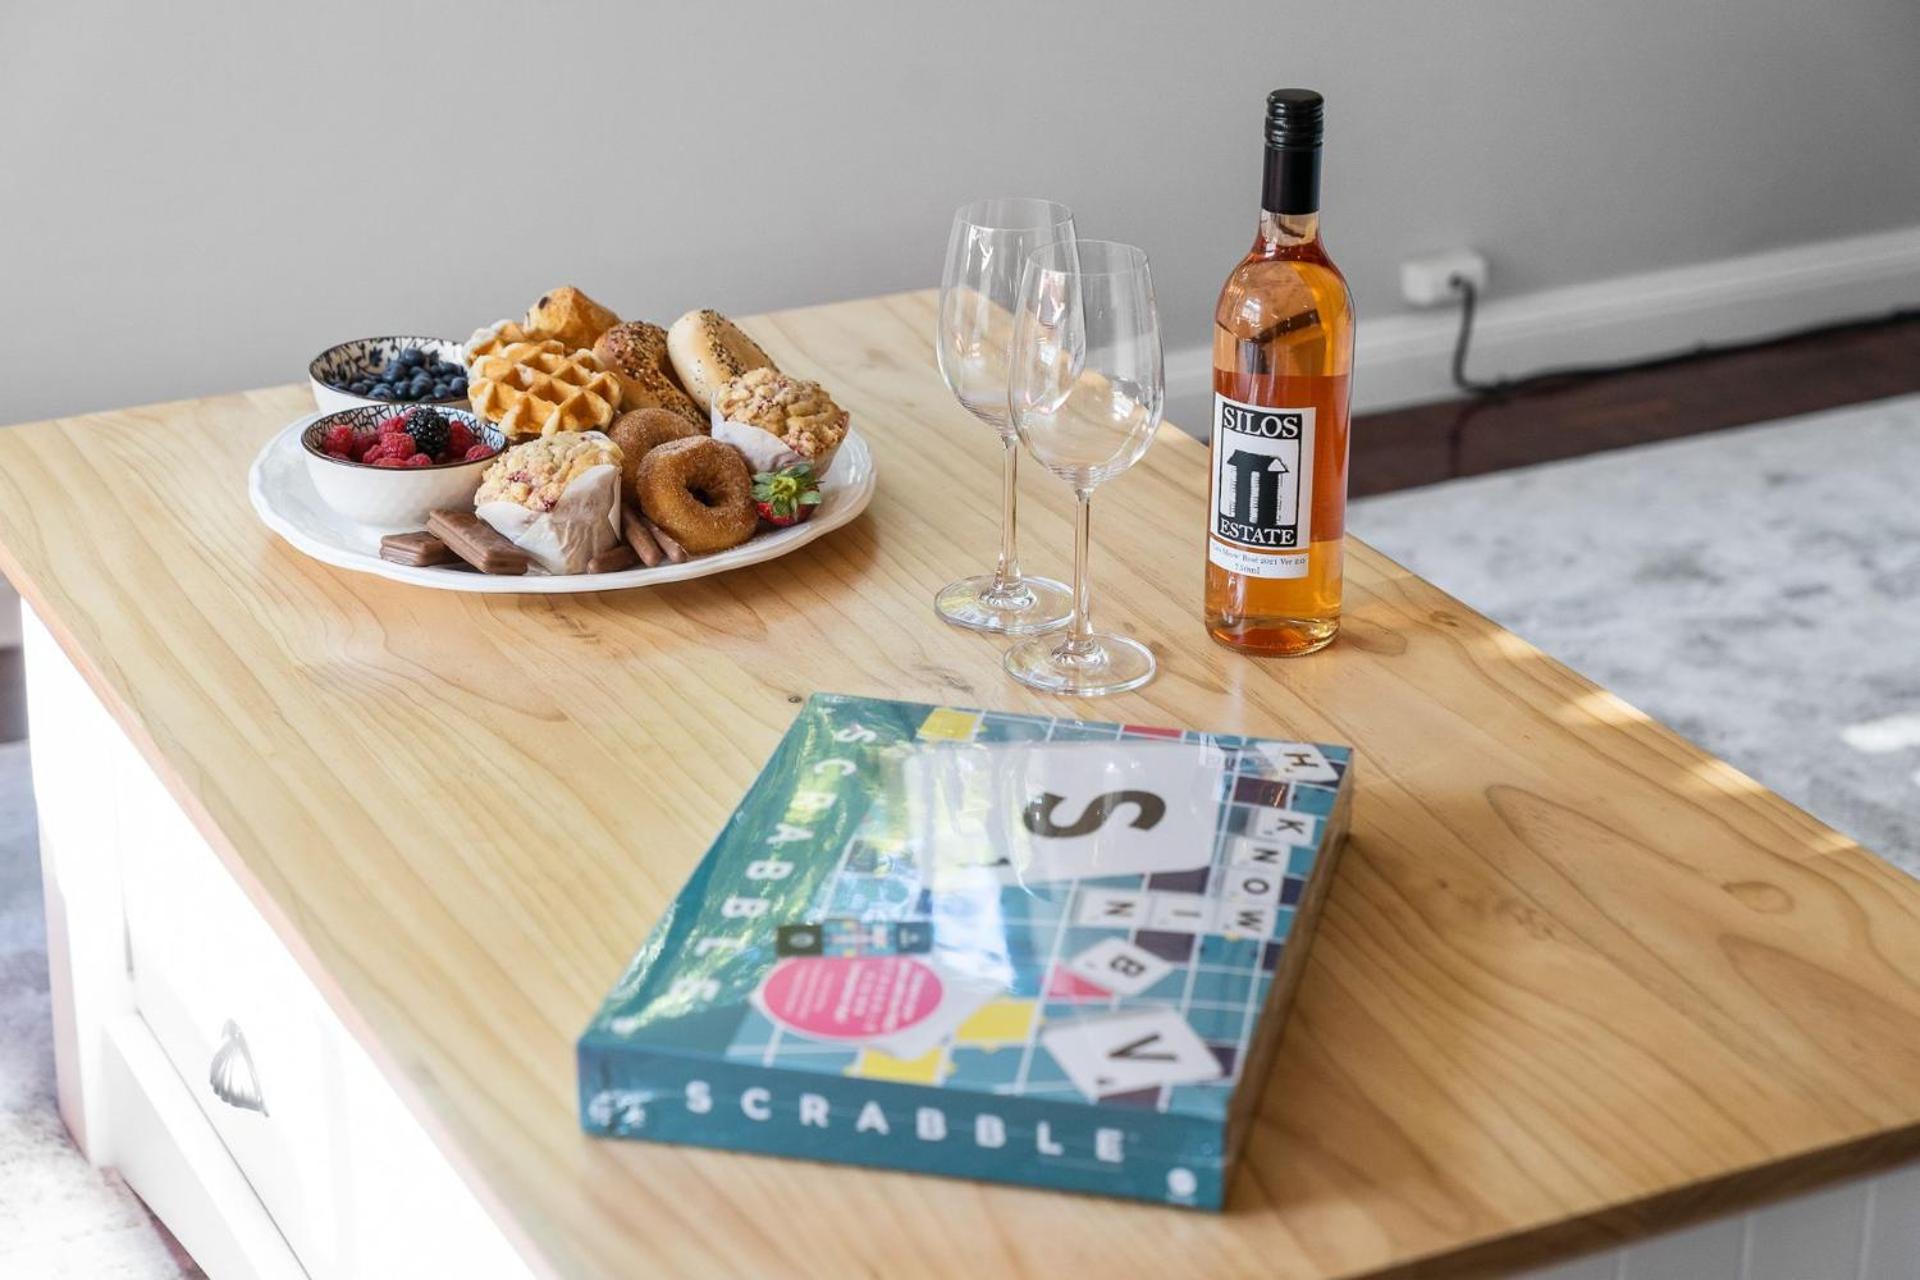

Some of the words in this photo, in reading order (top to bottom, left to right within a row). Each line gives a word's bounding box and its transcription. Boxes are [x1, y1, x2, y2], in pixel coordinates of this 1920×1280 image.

[1223, 406, 1299, 439] SILOS
[1220, 517, 1295, 546] ESTATE
[684, 1080, 1125, 1163] SCRABBLE
